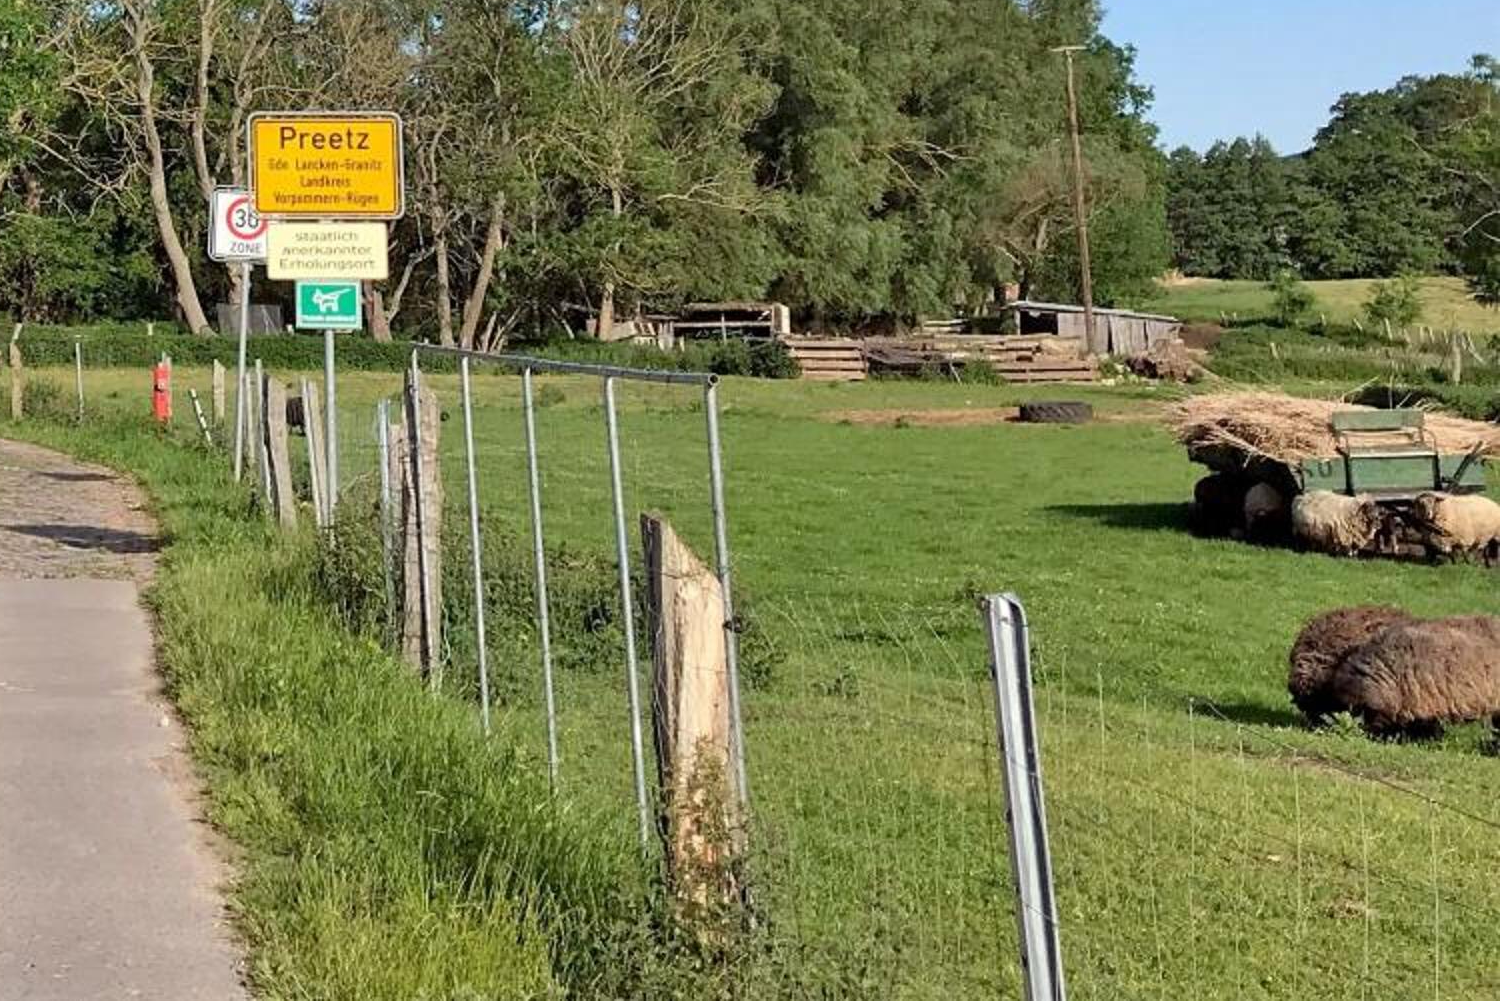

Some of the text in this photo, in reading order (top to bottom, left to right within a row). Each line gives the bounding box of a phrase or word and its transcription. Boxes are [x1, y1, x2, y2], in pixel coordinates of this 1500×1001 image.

[279, 126, 371, 150] Preetz
[299, 175, 351, 188] Landkreis
[235, 208, 259, 229] 30
[294, 230, 360, 242] staatlich
[229, 242, 262, 254] ZONE
[281, 245, 373, 256] anerkannter
[278, 257, 376, 271] Erholungsort
